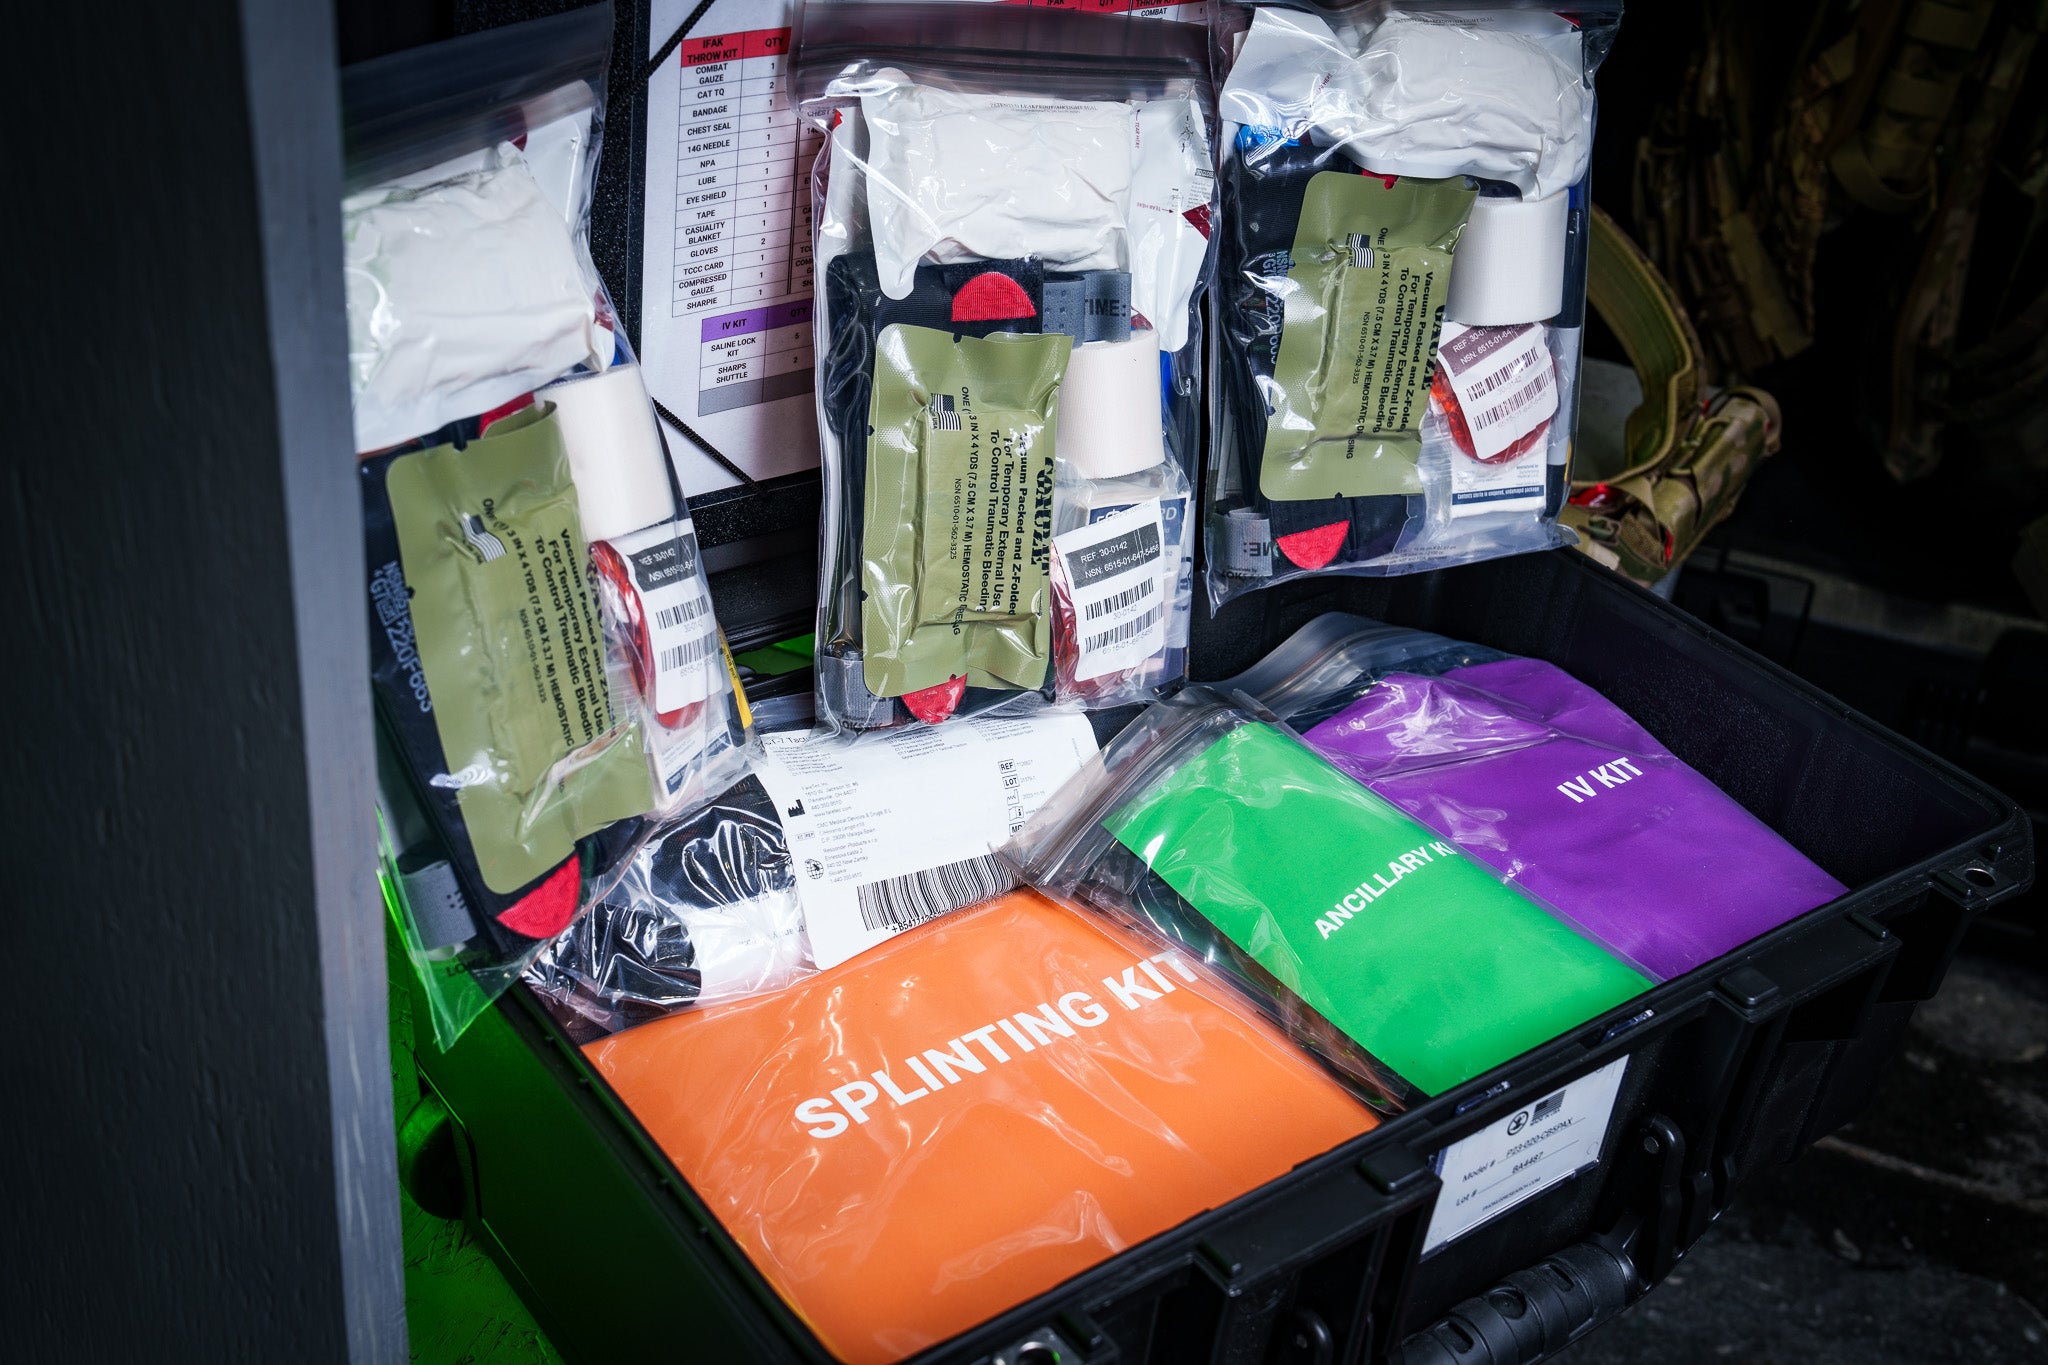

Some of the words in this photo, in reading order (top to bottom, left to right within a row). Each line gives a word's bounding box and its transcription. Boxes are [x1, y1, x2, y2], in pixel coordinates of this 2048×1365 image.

[1140, 8, 1167, 17] COMBAT
[703, 38, 723, 48] IFAK
[765, 37, 784, 48] QTY
[687, 51, 721, 64] THROW
[723, 49, 738, 59] KIT
[696, 63, 728, 75] COMBAT
[699, 74, 724, 85] GAUZE
[697, 91, 712, 99] CAT
[713, 88, 725, 98] TQ
[692, 105, 728, 118] BANDAGE
[687, 126, 711, 136] CHEST
[713, 122, 731, 132] SEAL
[687, 144, 701, 154] 14G
[702, 139, 731, 150] NEEDLE
[700, 159, 716, 169] NPA
[698, 175, 717, 186] LUBE
[686, 195, 701, 205] EYE
[701, 190, 727, 202] SHIELD
[696, 210, 716, 220] TAPE
[685, 221, 726, 236] CASUALITY
[1377, 227, 1389, 245] ONE
[688, 232, 722, 245] BLANKET
[690, 246, 719, 258] GLOVES
[684, 265, 703, 276] TCCC
[704, 261, 724, 271] CARD
[1382, 260, 1389, 269] IN
[678, 273, 727, 289] COMPRESSED
[1399, 266, 1409, 281] To
[690, 285, 715, 297] GAUZE
[1409, 274, 1420, 294] For
[1377, 286, 1387, 305] YDS
[1420, 271, 1433, 318] Vacuum
[686, 297, 717, 310] SHARPIE
[1085, 298, 1127, 318] IME:
[1392, 283, 1407, 326] Control
[790, 307, 808, 318] QTY
[1361, 311, 1370, 325] NSN
[1373, 305, 1384, 321] (7.5
[722, 321, 731, 331] IV
[733, 318, 747, 329] KIT
[1372, 322, 1382, 336] CM
[1398, 295, 1417, 357] Temporary
[711, 340, 736, 352] SALINE
[737, 336, 757, 347] LOCK
[1412, 320, 1426, 363] Packed
[727, 349, 739, 358] KIT
[1369, 345, 1377, 356] 3.7
[1381, 327, 1401, 384] Traumatic
[718, 362, 747, 374] SHARPS
[1365, 358, 1375, 370] M)
[716, 371, 748, 384] SHUTTLE
[1389, 358, 1407, 404] External
[1407, 365, 1418, 387] and
[961, 386, 970, 406] ONE
[1356, 370, 1372, 423] HEMOSTATIC
[1371, 385, 1391, 434] Bleeding
[1384, 405, 1398, 428] Use
[1398, 388, 1414, 430] Z-Folde
[970, 421, 978, 431] IN
[989, 429, 999, 443] To
[1003, 437, 1012, 458] For
[969, 450, 978, 470] YDS
[988, 446, 1001, 493] Control
[953, 478, 961, 493] NSN
[966, 471, 977, 489] (7.5
[966, 489, 976, 505] CM
[998, 461, 1014, 527] Temporary
[966, 506, 975, 514] X
[1015, 487, 1027, 534] Packed
[950, 494, 960, 559] 6510-01-562-3325
[964, 515, 974, 529] 3.7
[982, 494, 999, 557] Traumatic
[962, 530, 972, 542] M)
[533, 535, 547, 555] To
[547, 539, 563, 565] For
[1012, 536, 1023, 560] and
[1081, 550, 1100, 564] REF:
[1100, 541, 1128, 558] 30-0142
[517, 550, 526, 560] X
[993, 529, 1010, 581] External
[520, 560, 530, 569] 4
[1085, 565, 1103, 579] NSN:
[958, 544, 971, 602] HEMOSTATIC
[522, 570, 537, 593] YDS
[539, 556, 566, 611] Control
[1007, 563, 1021, 616] Z-Folded
[559, 527, 584, 588] Vacuum
[578, 591, 597, 645] Packed
[592, 648, 604, 674] and
[991, 582, 1004, 606] Use
[528, 594, 542, 615] (7.5
[553, 566, 587, 644] Temporary
[535, 616, 548, 634] CM
[540, 635, 550, 644] X
[542, 645, 554, 661] 3.7
[555, 611, 584, 685] Traumatic
[544, 662, 557, 677] M)
[576, 645, 600, 705] External
[549, 678, 575, 747] HEMOSTATIC
[574, 686, 595, 740] Bleedin
[592, 706, 605, 735] Use
[1001, 761, 1014, 771] REF
[1005, 777, 1018, 787] LOT
[1557, 776, 1594, 803] IV
[1588, 757, 1644, 789] KIT
[1314, 846, 1434, 940] ANCILLARY
[1429, 841, 1458, 858] KI
[795, 990, 1109, 1139] SPLINTING
[1102, 950, 1198, 1011] KIT
